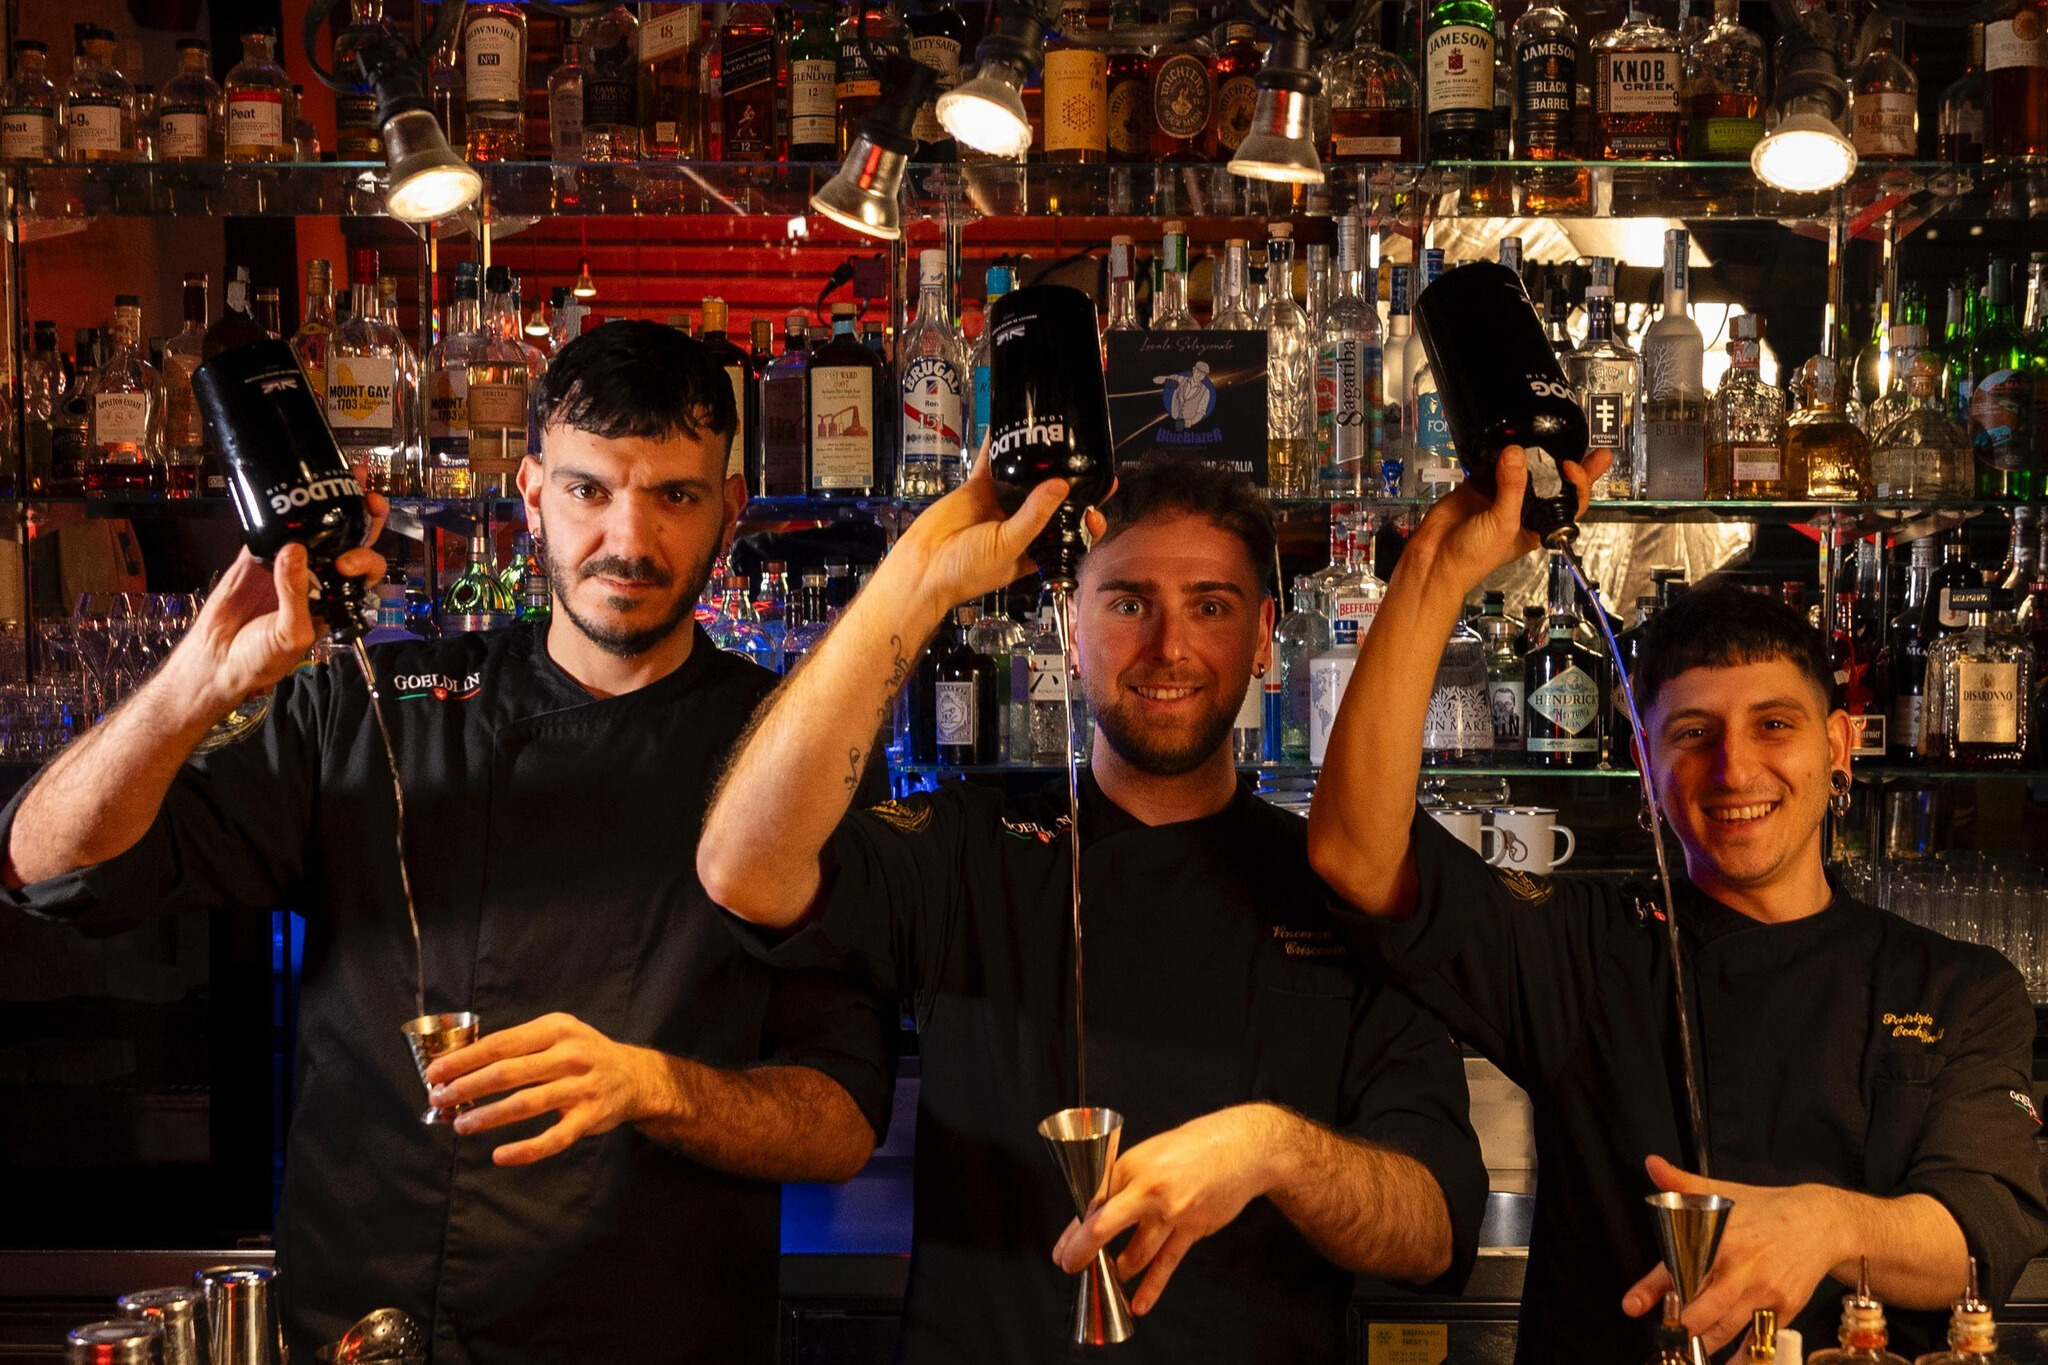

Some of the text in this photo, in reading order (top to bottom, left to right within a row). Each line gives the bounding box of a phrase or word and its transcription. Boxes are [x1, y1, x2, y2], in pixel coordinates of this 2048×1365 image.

[467, 25, 517, 42] BOWMORE
[661, 25, 673, 38] 18
[911, 38, 934, 51] UTTY
[1429, 32, 1489, 55] JAMESON
[1522, 43, 1576, 62] JAMESON
[747, 53, 771, 67] LABEL
[807, 64, 820, 72] THE
[1613, 60, 1665, 83] KNOB
[794, 72, 835, 83] GLENLIVE
[808, 87, 819, 97] 12
[845, 83, 855, 92] 12
[1536, 81, 1568, 93] BLACK
[1623, 83, 1675, 91] CREEK
[1532, 98, 1570, 110] BARREL
[1673, 91, 1680, 107] 9
[231, 108, 256, 119] Peat
[4, 122, 27, 132] Peat
[741, 142, 751, 152] 12
[841, 371, 857, 379] WARD
[905, 361, 958, 394] BRUGAL
[330, 385, 390, 398] MOUNT GAY
[98, 398, 143, 410] APPLETON ESTATE
[337, 399, 357, 410] 1703
[431, 397, 463, 409] MOUNT
[439, 410, 457, 421] 1703
[919, 414, 945, 429] 151
[1427, 419, 1449, 433] FON
[989, 423, 1064, 461] BULLDO
[1340, 603, 1379, 616] BEEFEATE
[1963, 690, 2013, 701] DISARONNO
